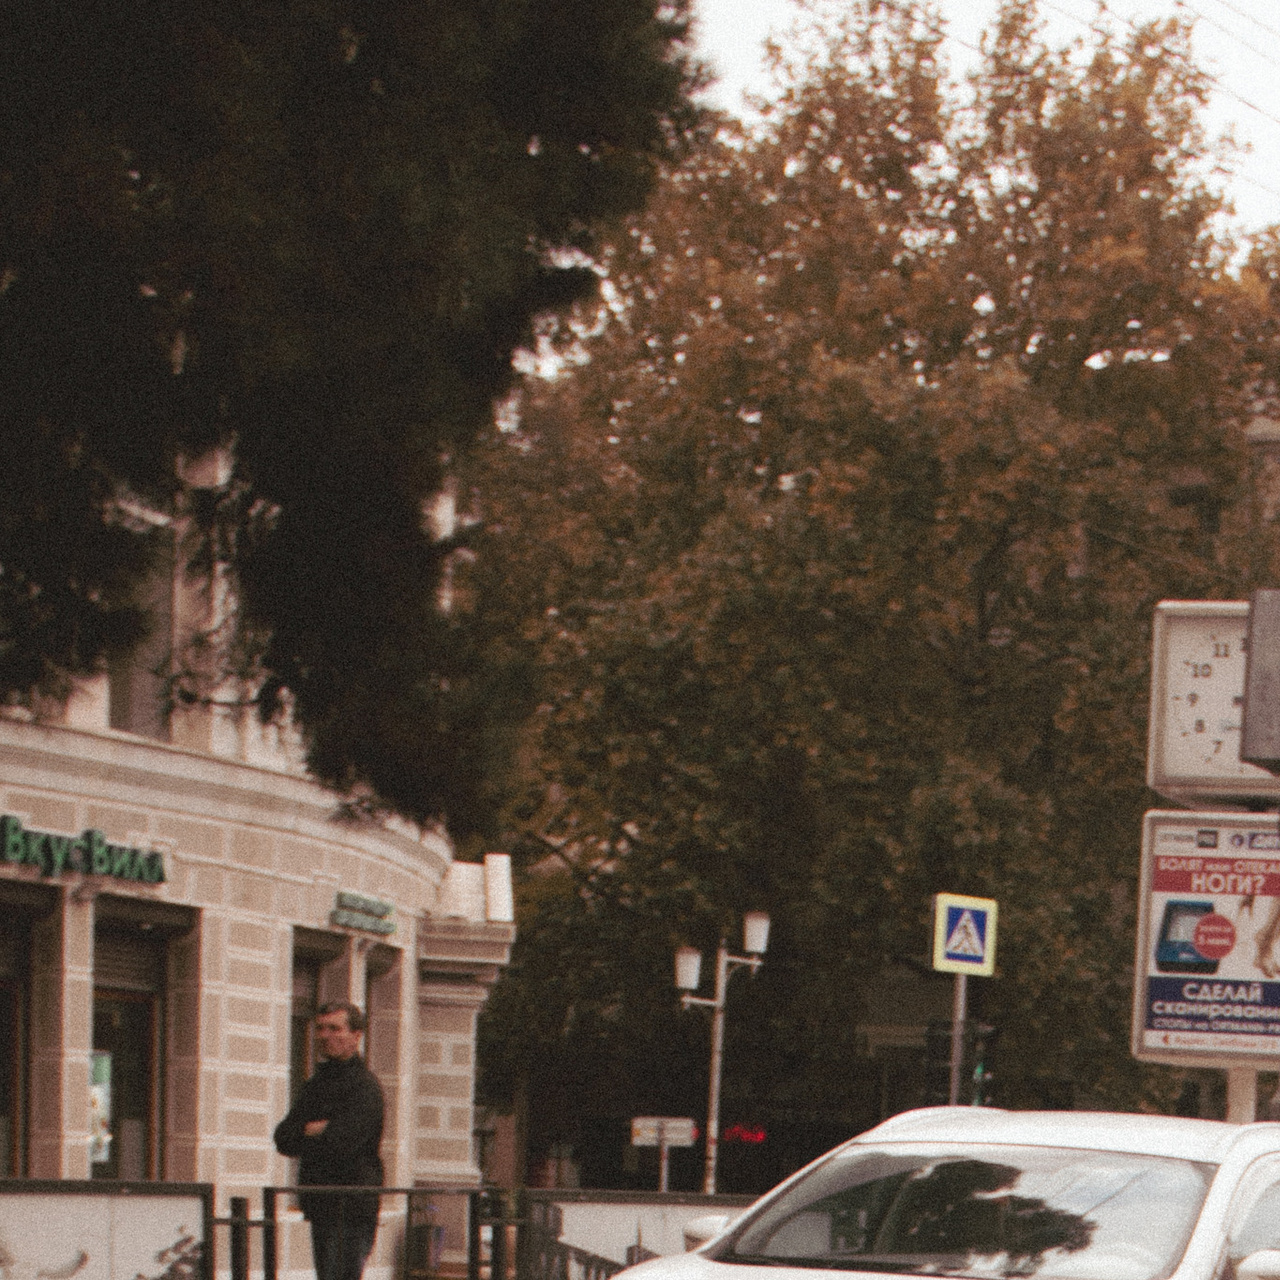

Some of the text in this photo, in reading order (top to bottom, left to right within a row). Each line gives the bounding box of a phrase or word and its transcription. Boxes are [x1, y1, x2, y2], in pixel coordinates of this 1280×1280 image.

[1213, 643, 1229, 657] 11
[1192, 663, 1212, 678] 10
[1213, 739, 1223, 753] 7
[1191, 873, 1265, 894] НОГИ?
[1182, 982, 1262, 1003] СДЕЛАЙ
